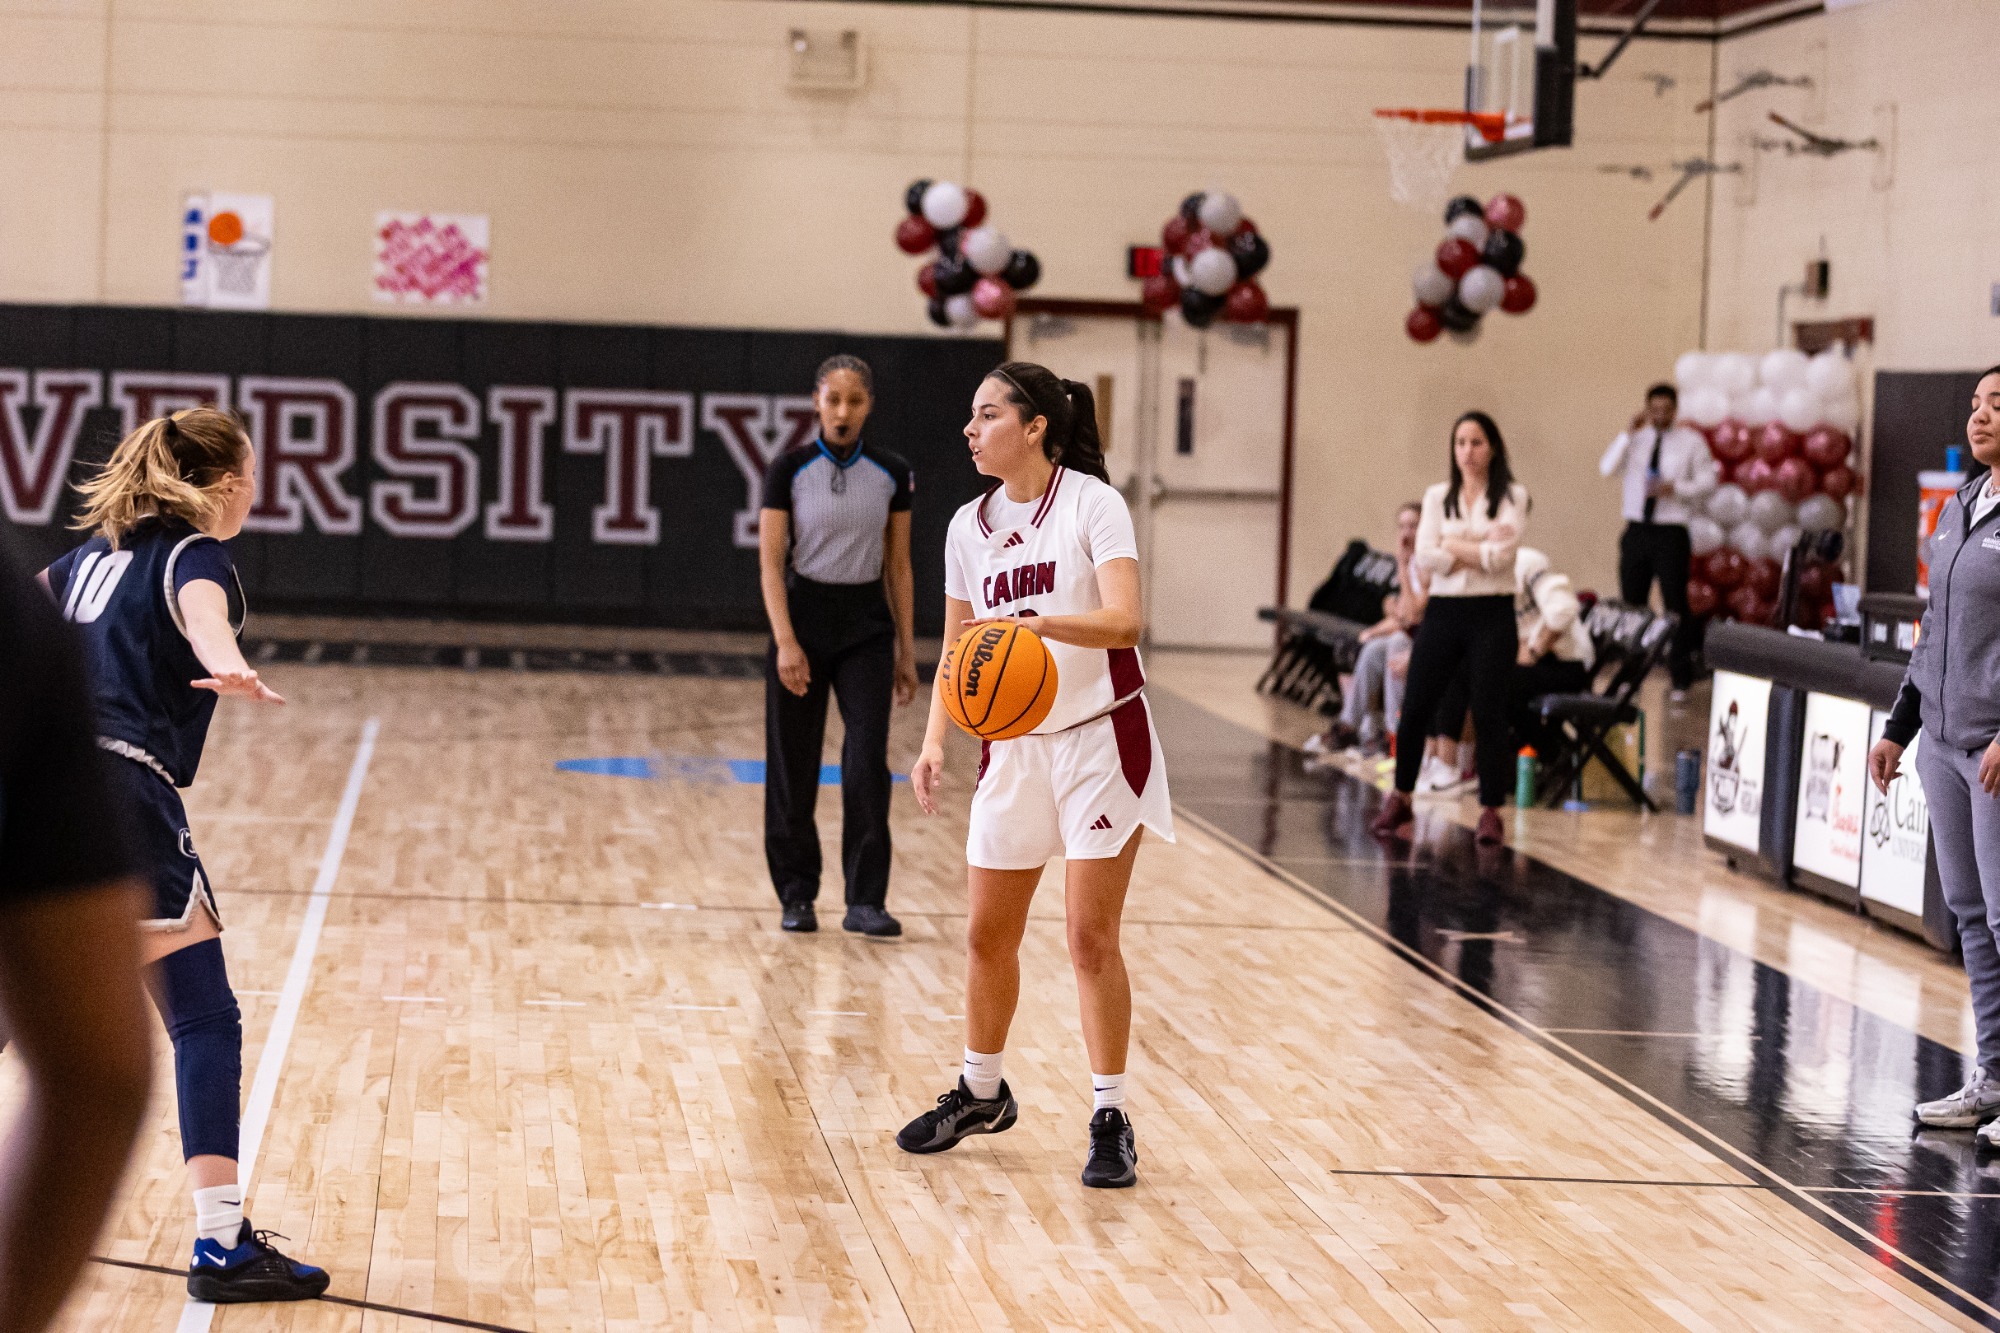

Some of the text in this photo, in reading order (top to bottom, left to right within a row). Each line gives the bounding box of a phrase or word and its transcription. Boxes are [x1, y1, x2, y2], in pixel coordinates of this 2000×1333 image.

[63, 550, 134, 623] 10
[983, 561, 1056, 609] CAIRN
[965, 628, 1007, 697] Wilson
